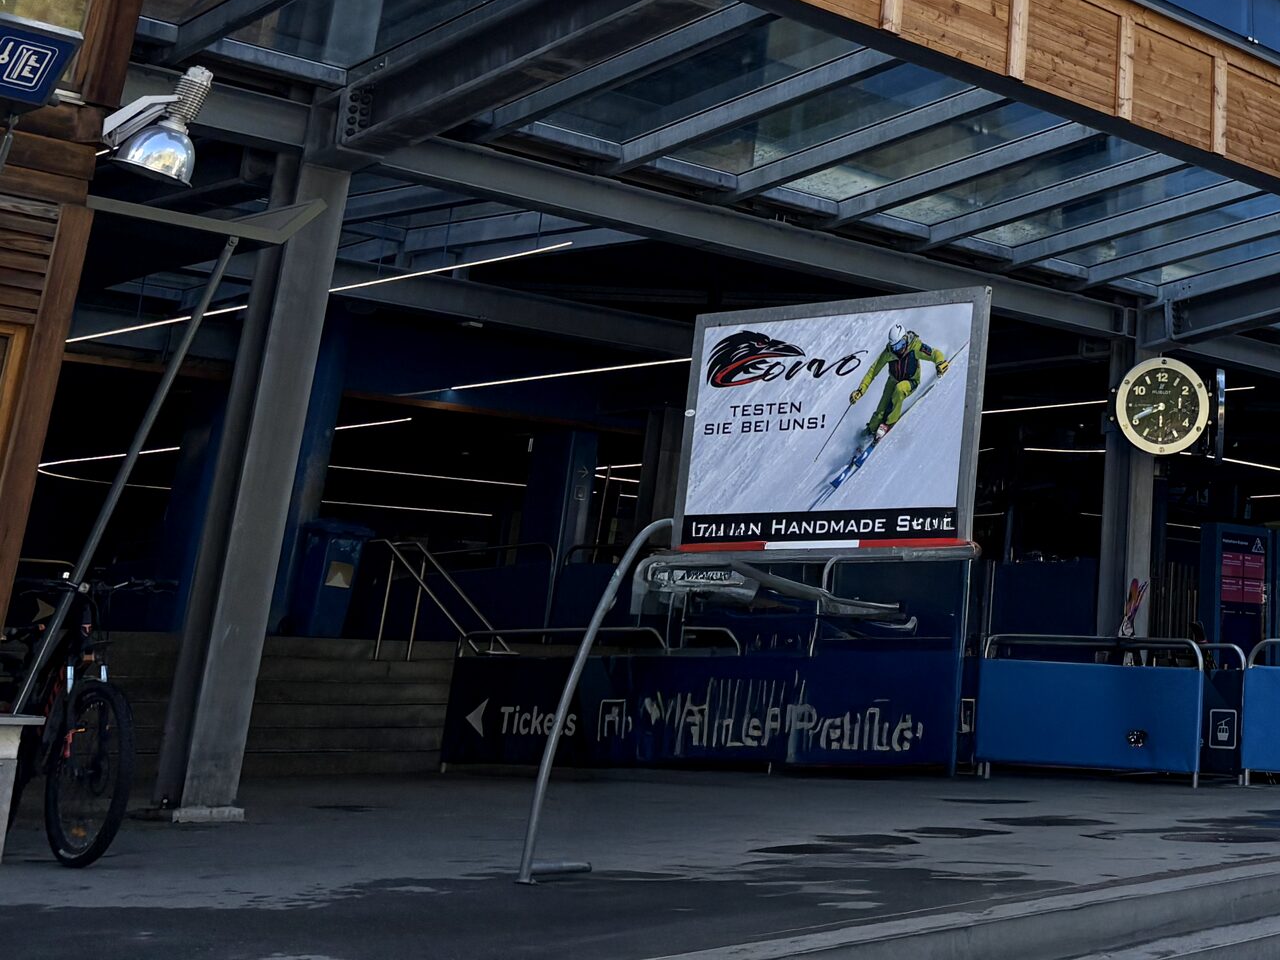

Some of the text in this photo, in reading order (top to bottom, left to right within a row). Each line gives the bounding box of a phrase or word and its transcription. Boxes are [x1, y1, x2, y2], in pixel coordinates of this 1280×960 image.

[1156, 372, 1168, 382] 12
[1133, 385, 1145, 395] 10
[1181, 386, 1189, 395] 2
[730, 401, 802, 417] TESTEN
[704, 414, 826, 435] SIE BEI UNS!
[1182, 418, 1189, 427] 4
[771, 518, 886, 535] HANDMADE
[500, 705, 577, 737] Tickes
